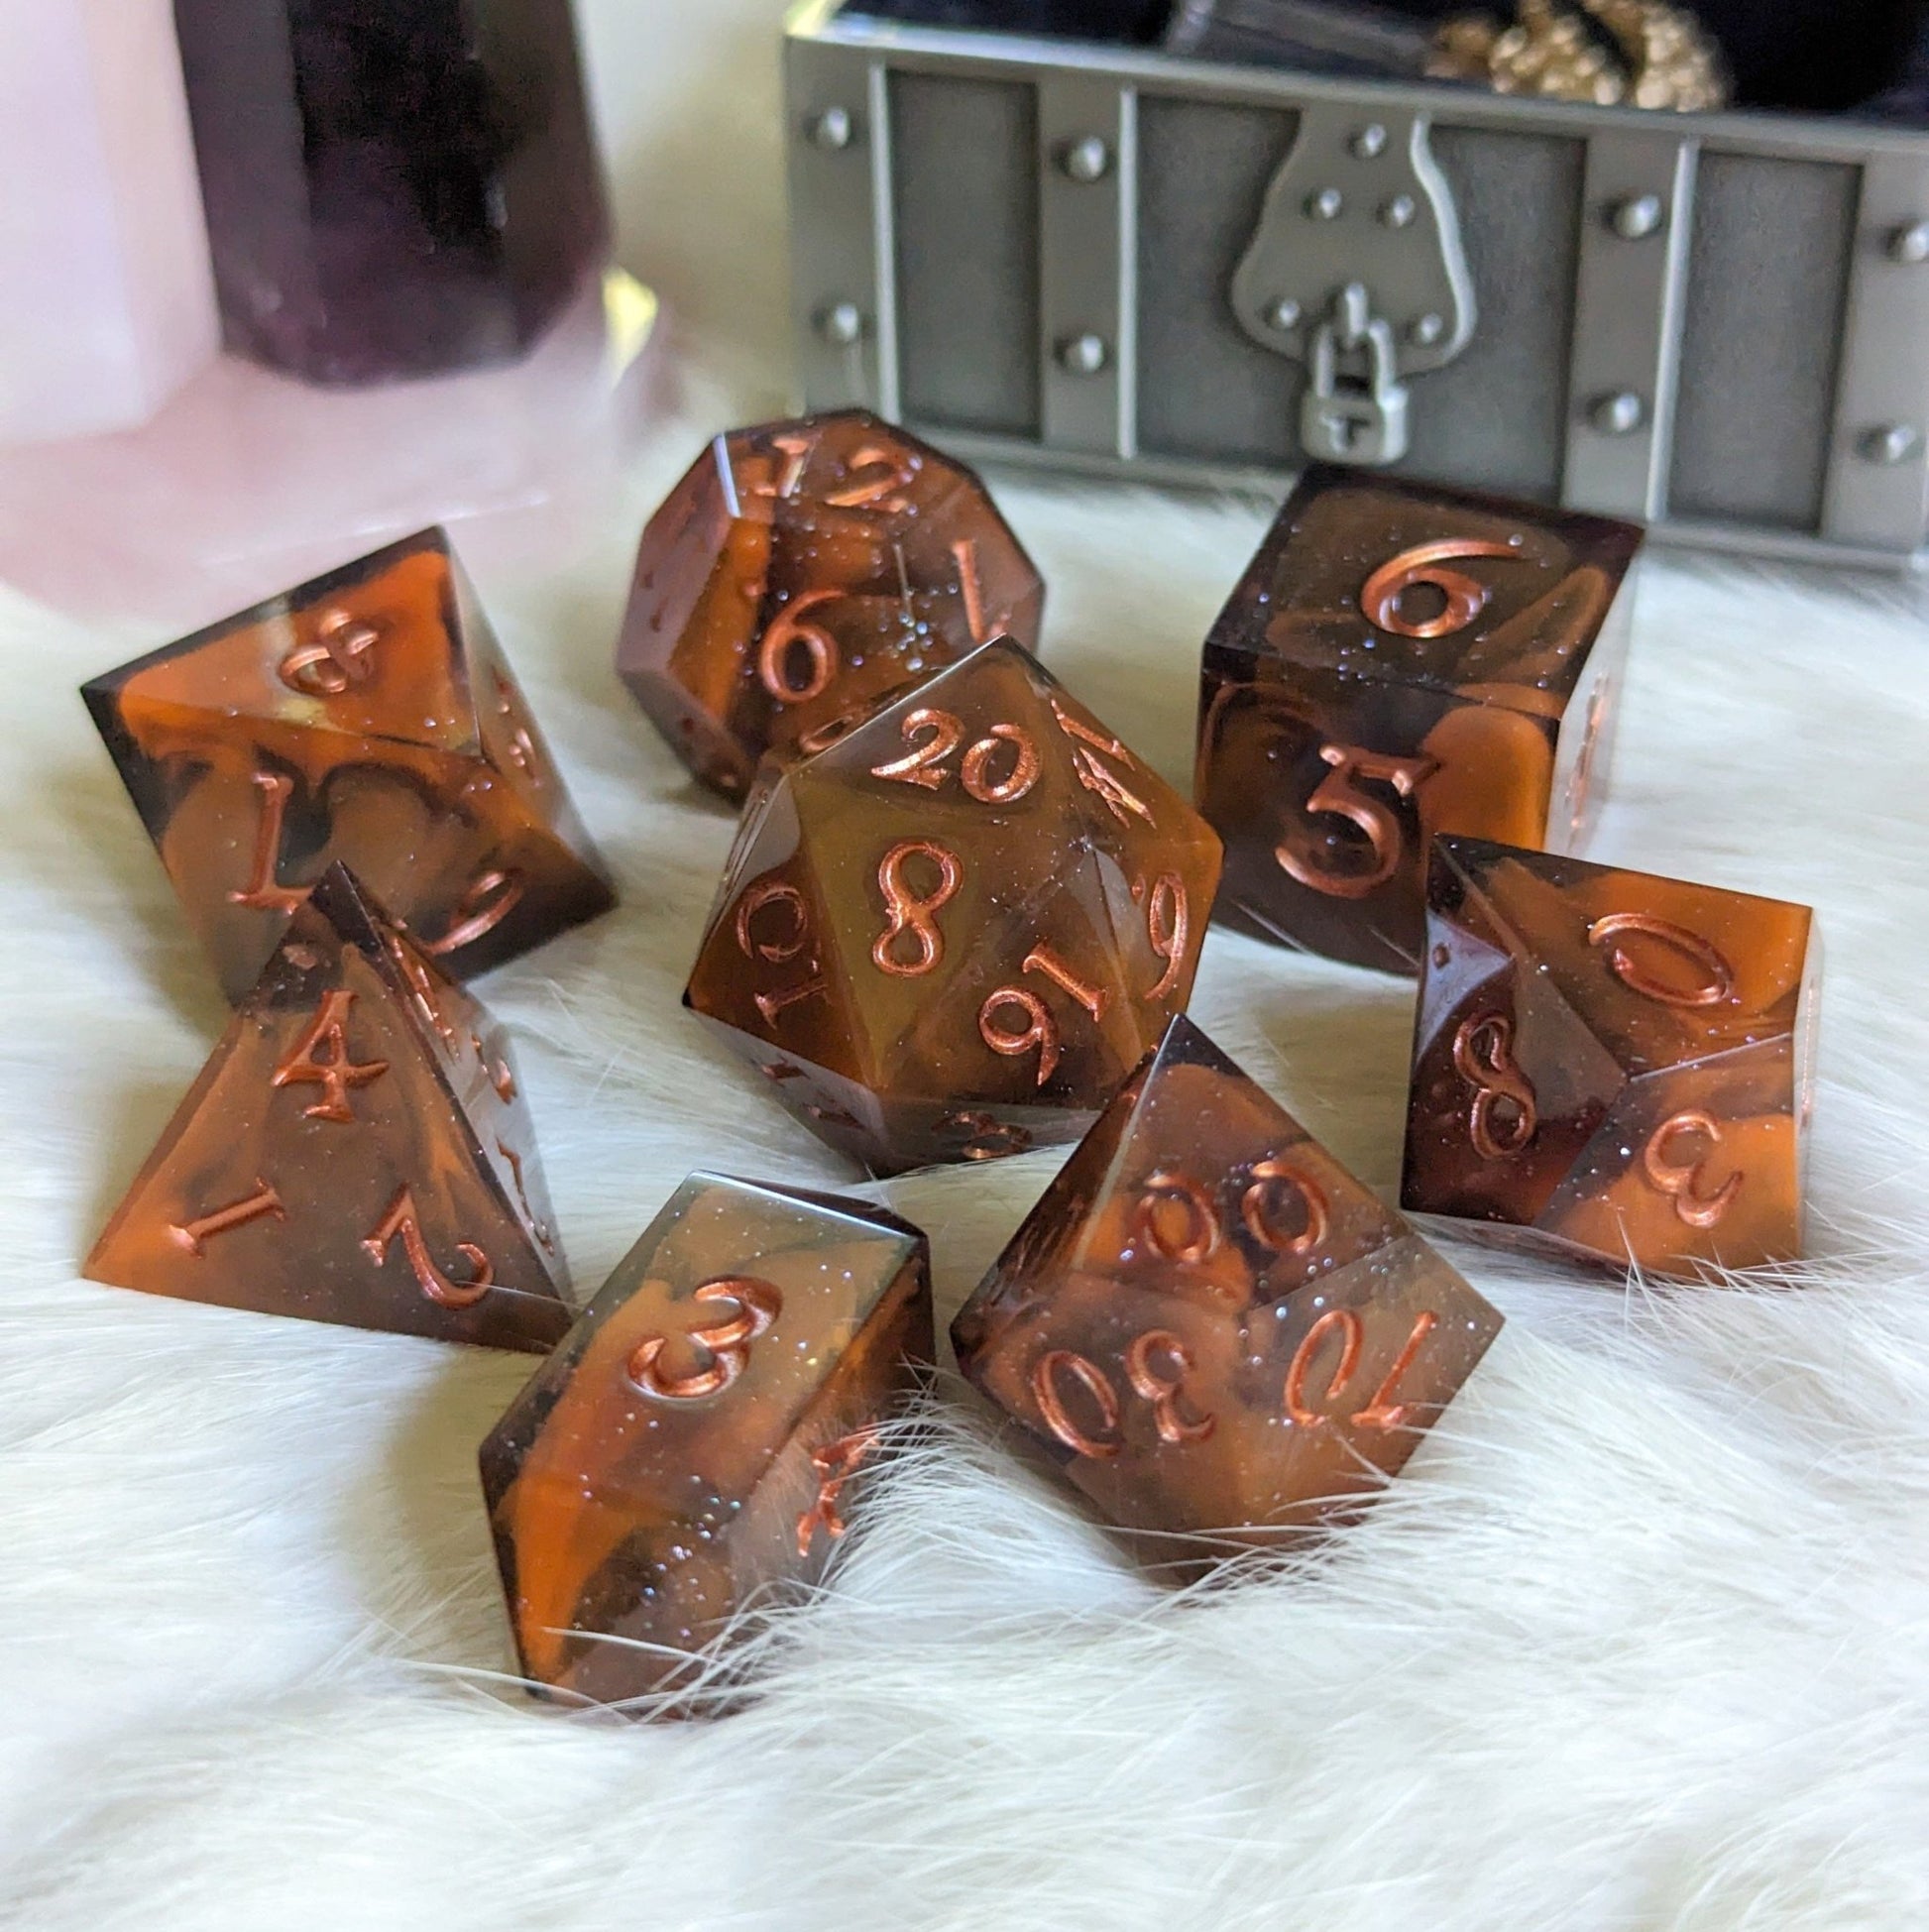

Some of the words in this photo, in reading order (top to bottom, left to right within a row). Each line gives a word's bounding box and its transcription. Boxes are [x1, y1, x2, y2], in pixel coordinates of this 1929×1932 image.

[1361, 538, 1524, 638] 6
[870, 709, 1042, 804] 20
[1275, 744, 1442, 897] 5
[872, 842, 964, 977] 8
[1589, 913, 1735, 1006] 0
[272, 989, 390, 1124] 4
[1453, 1011, 1536, 1158] 8
[169, 1177, 286, 1260] 1
[1645, 1109, 1745, 1228] 3
[360, 1182, 494, 1310] 2
[625, 1275, 784, 1399] 3
